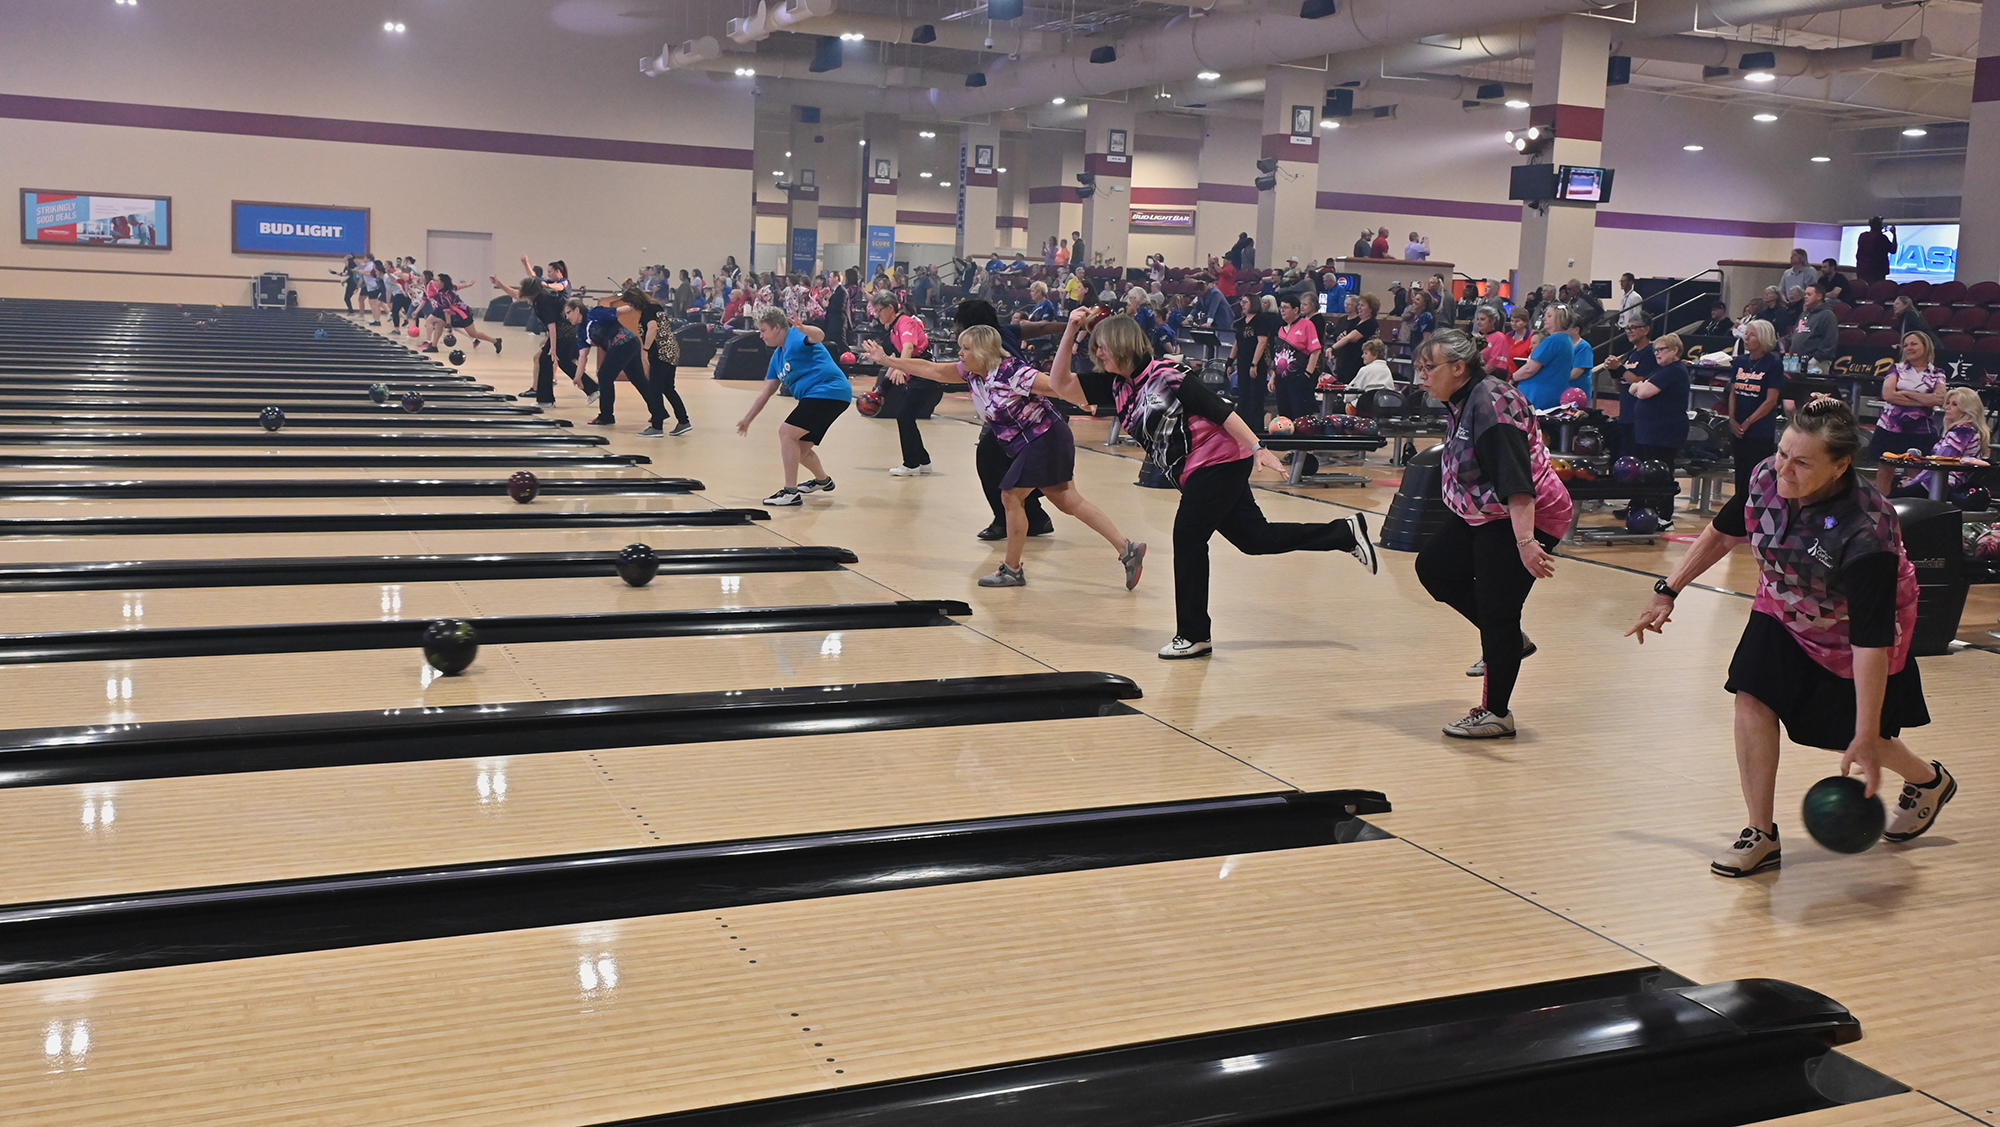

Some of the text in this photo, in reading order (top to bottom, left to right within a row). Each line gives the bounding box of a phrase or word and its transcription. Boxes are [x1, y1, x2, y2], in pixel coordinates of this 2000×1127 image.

[36, 202, 76, 216] STRIKINGLY
[36, 211, 77, 225] GOOD DEALS
[259, 222, 343, 238] BUD LIGHT
